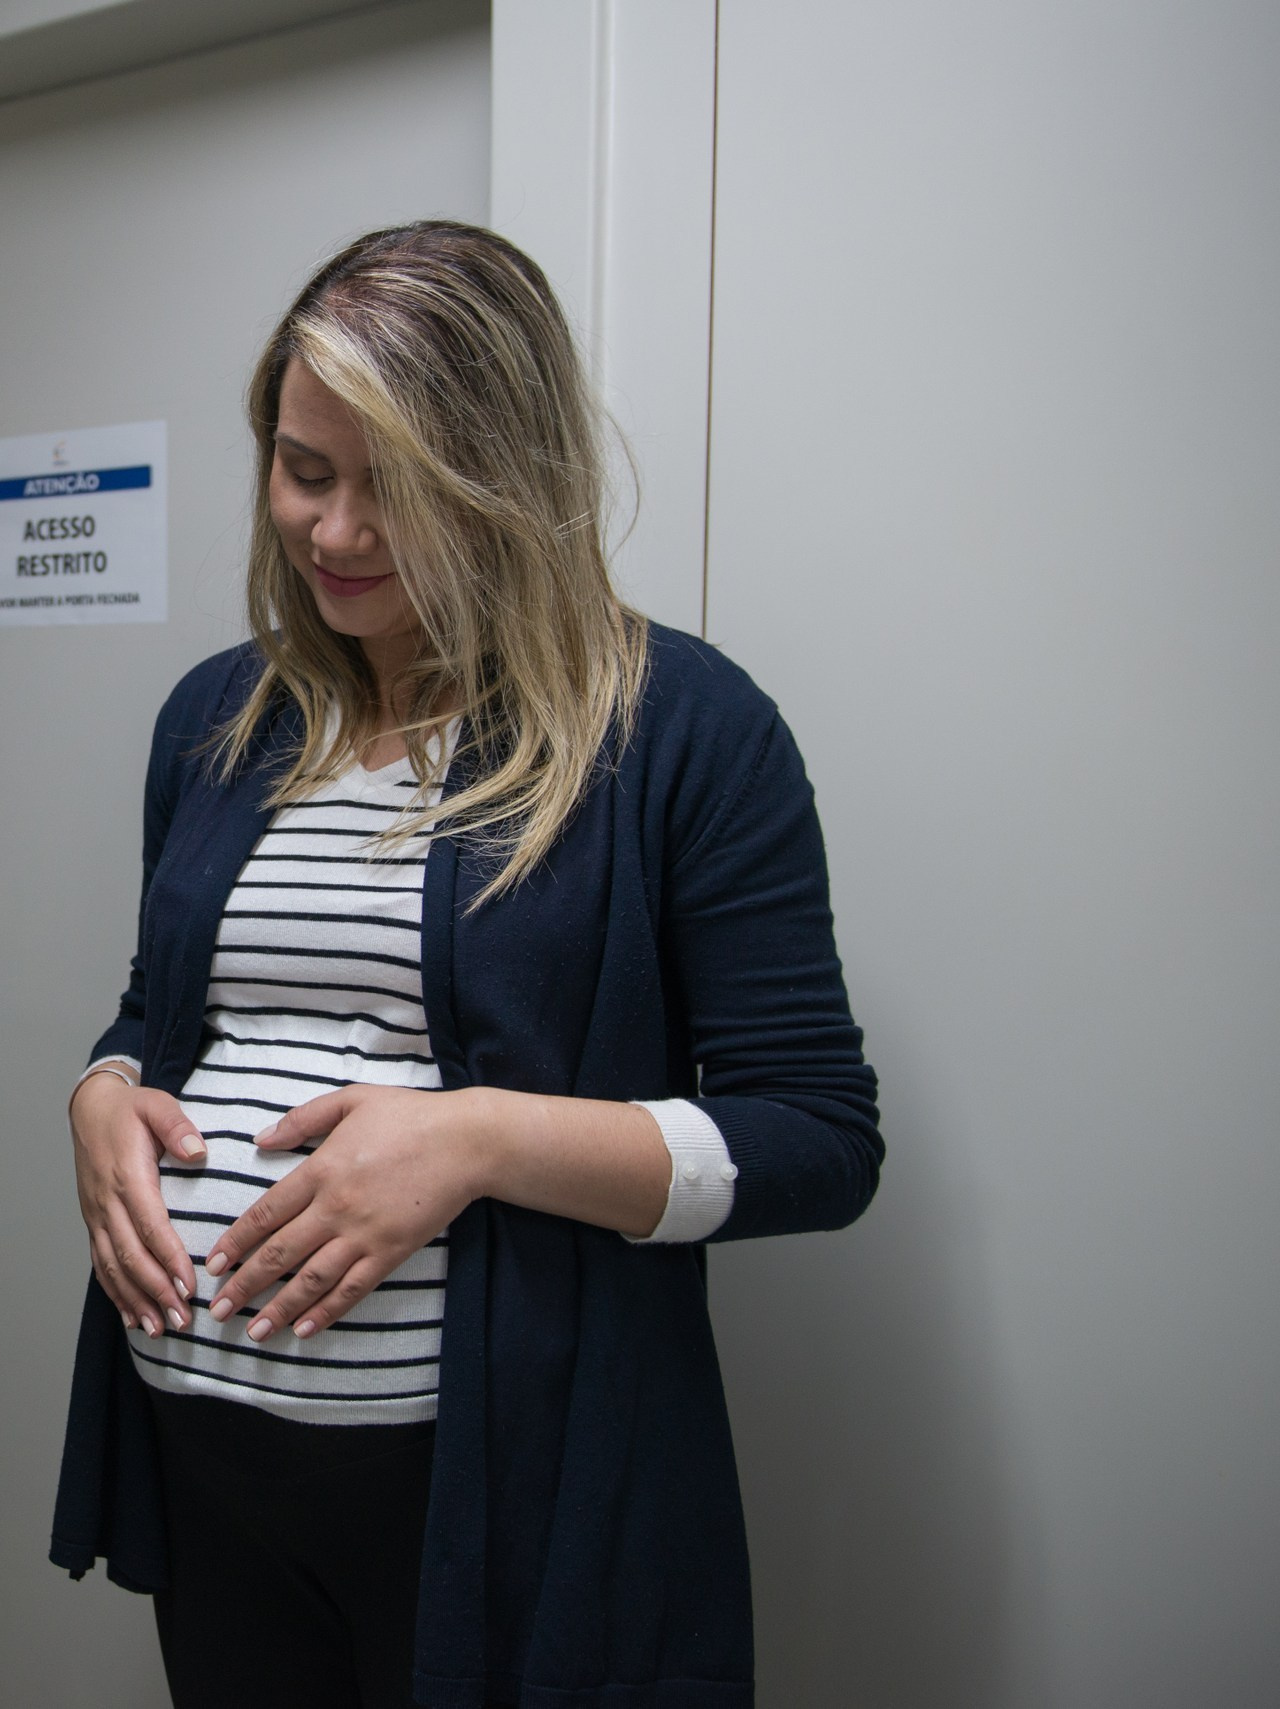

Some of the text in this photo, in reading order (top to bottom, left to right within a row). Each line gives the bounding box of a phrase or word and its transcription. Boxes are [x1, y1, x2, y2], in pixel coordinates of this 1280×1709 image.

[24, 474, 100, 496] ATENÇÃO
[23, 516, 95, 541] ACESSO
[17, 551, 107, 577] RESTRITO
[19, 596, 54, 608] MANTER
[66, 595, 93, 606] PORTA
[97, 593, 140, 605] FECHADA
